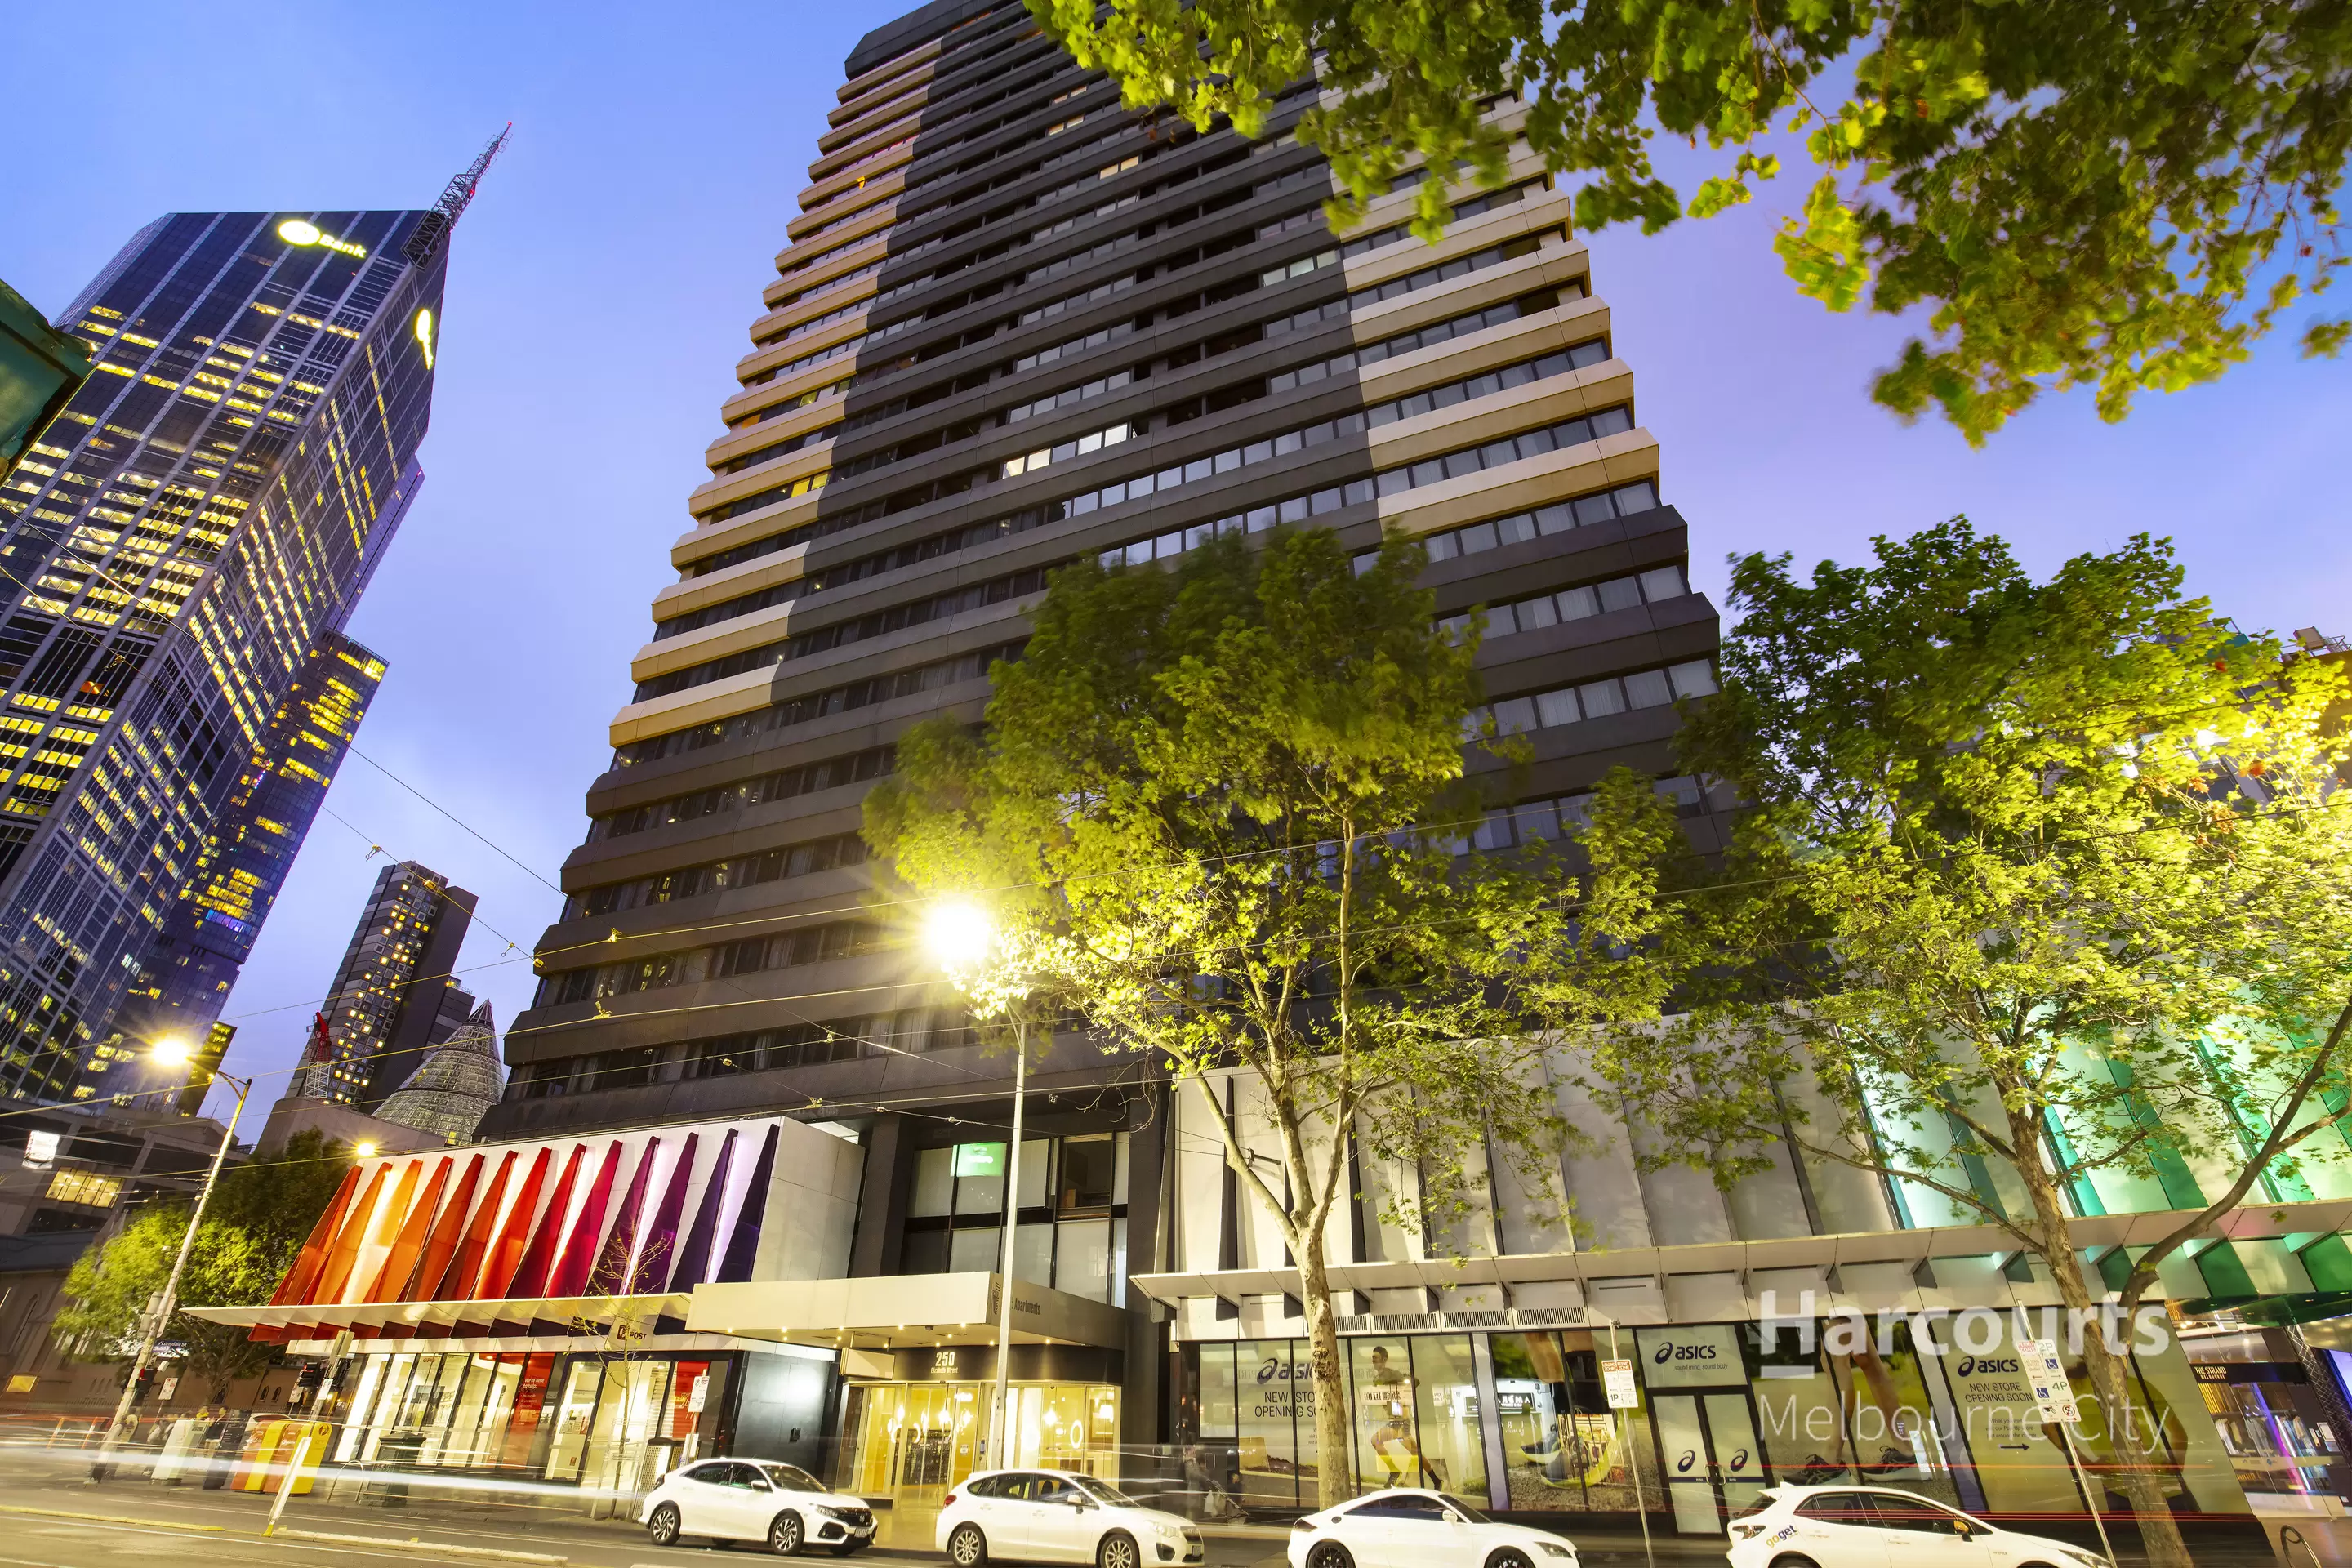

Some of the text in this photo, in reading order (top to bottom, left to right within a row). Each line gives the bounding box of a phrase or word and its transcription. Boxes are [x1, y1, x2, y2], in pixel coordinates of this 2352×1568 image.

[318, 234, 367, 259] Bank
[1014, 1297, 1040, 1316] Apartments
[1675, 1345, 1716, 1360] asics
[935, 1352, 955, 1367] 250
[1977, 1359, 2019, 1373] asics
[1278, 1363, 1312, 1379] asi
[2194, 1366, 2227, 1374] THE STRAND
[1969, 1383, 1990, 1392] NEW
[1993, 1382, 2022, 1392] STORE
[2052, 1382, 2067, 1391] 4P
[1264, 1392, 1315, 1403] NEW STO
[1610, 1393, 1619, 1401] 1P
[1965, 1392, 2005, 1402] OPENING
[2006, 1392, 2034, 1402] SOON
[1254, 1405, 1304, 1417] OPENING
[1766, 1525, 1797, 1548] goget
